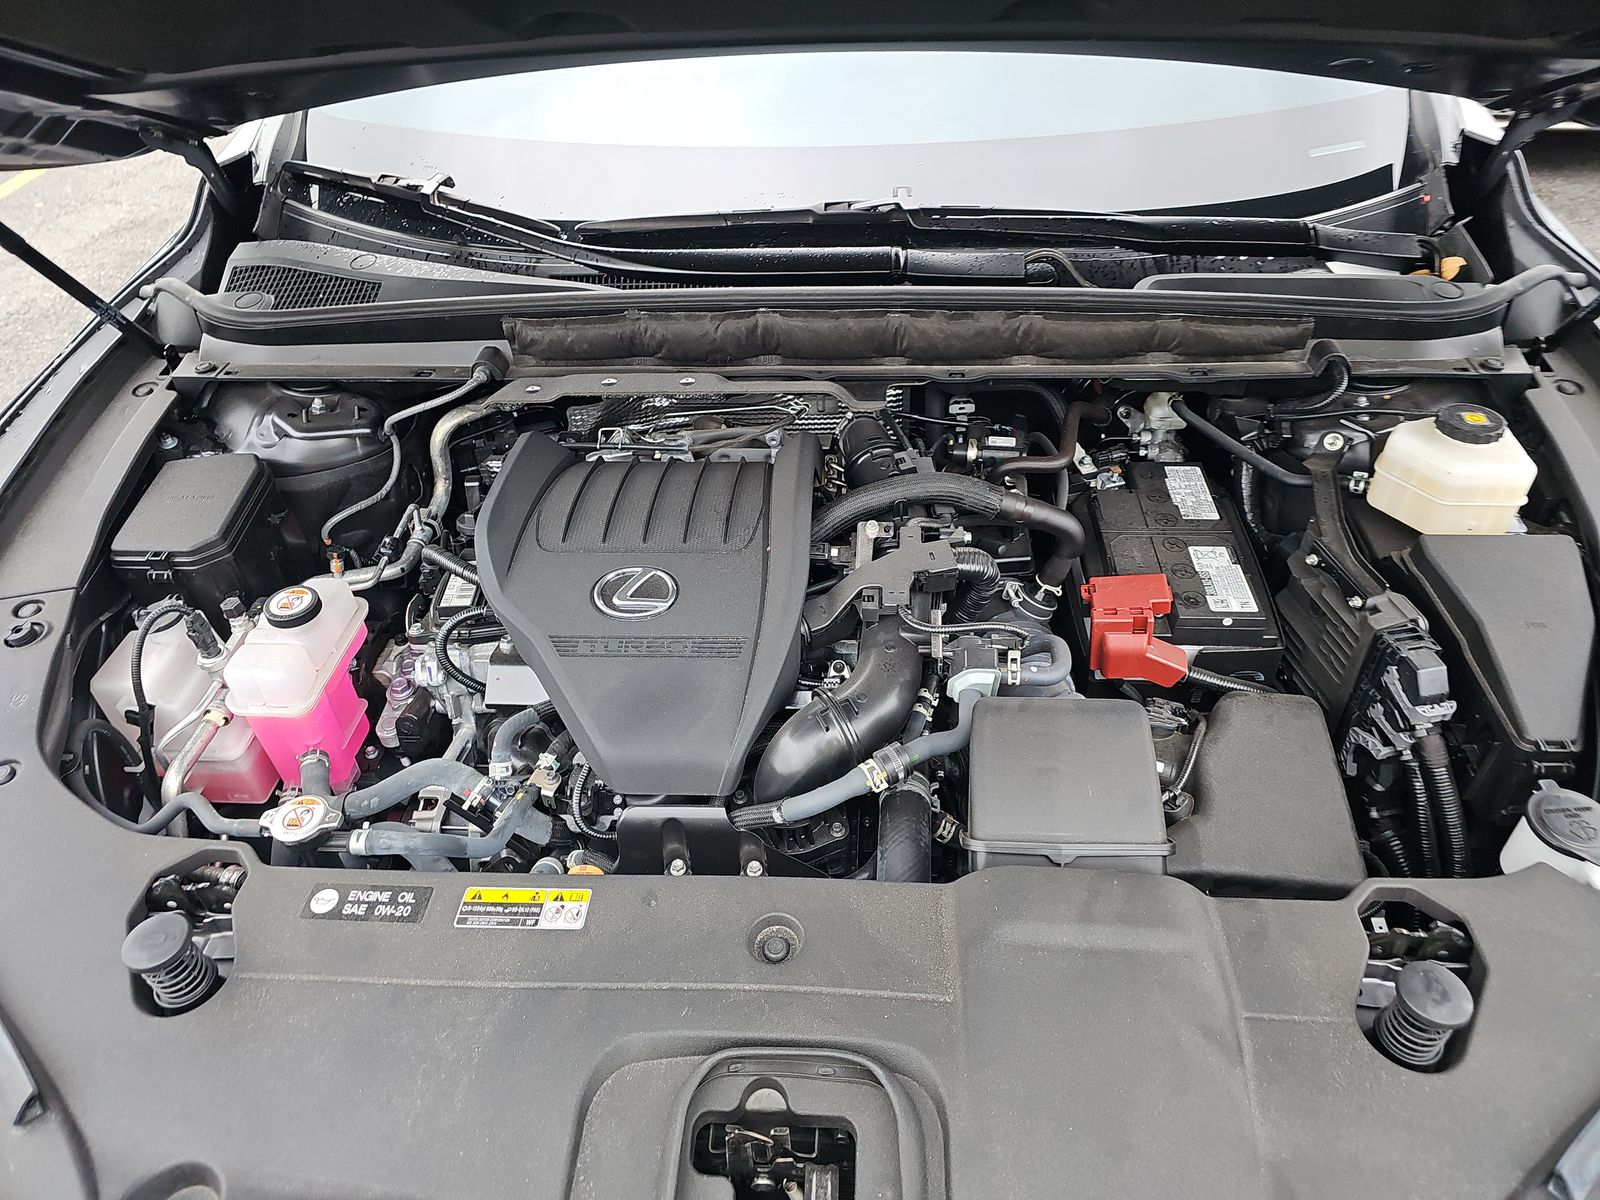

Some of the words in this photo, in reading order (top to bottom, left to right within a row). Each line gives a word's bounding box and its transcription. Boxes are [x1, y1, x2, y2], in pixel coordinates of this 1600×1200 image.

[578, 637, 692, 655] TURBO
[347, 890, 392, 903] ENGINE
[397, 891, 416, 904] OIL
[341, 903, 369, 915] SAE
[374, 904, 411, 917] 0W-20
